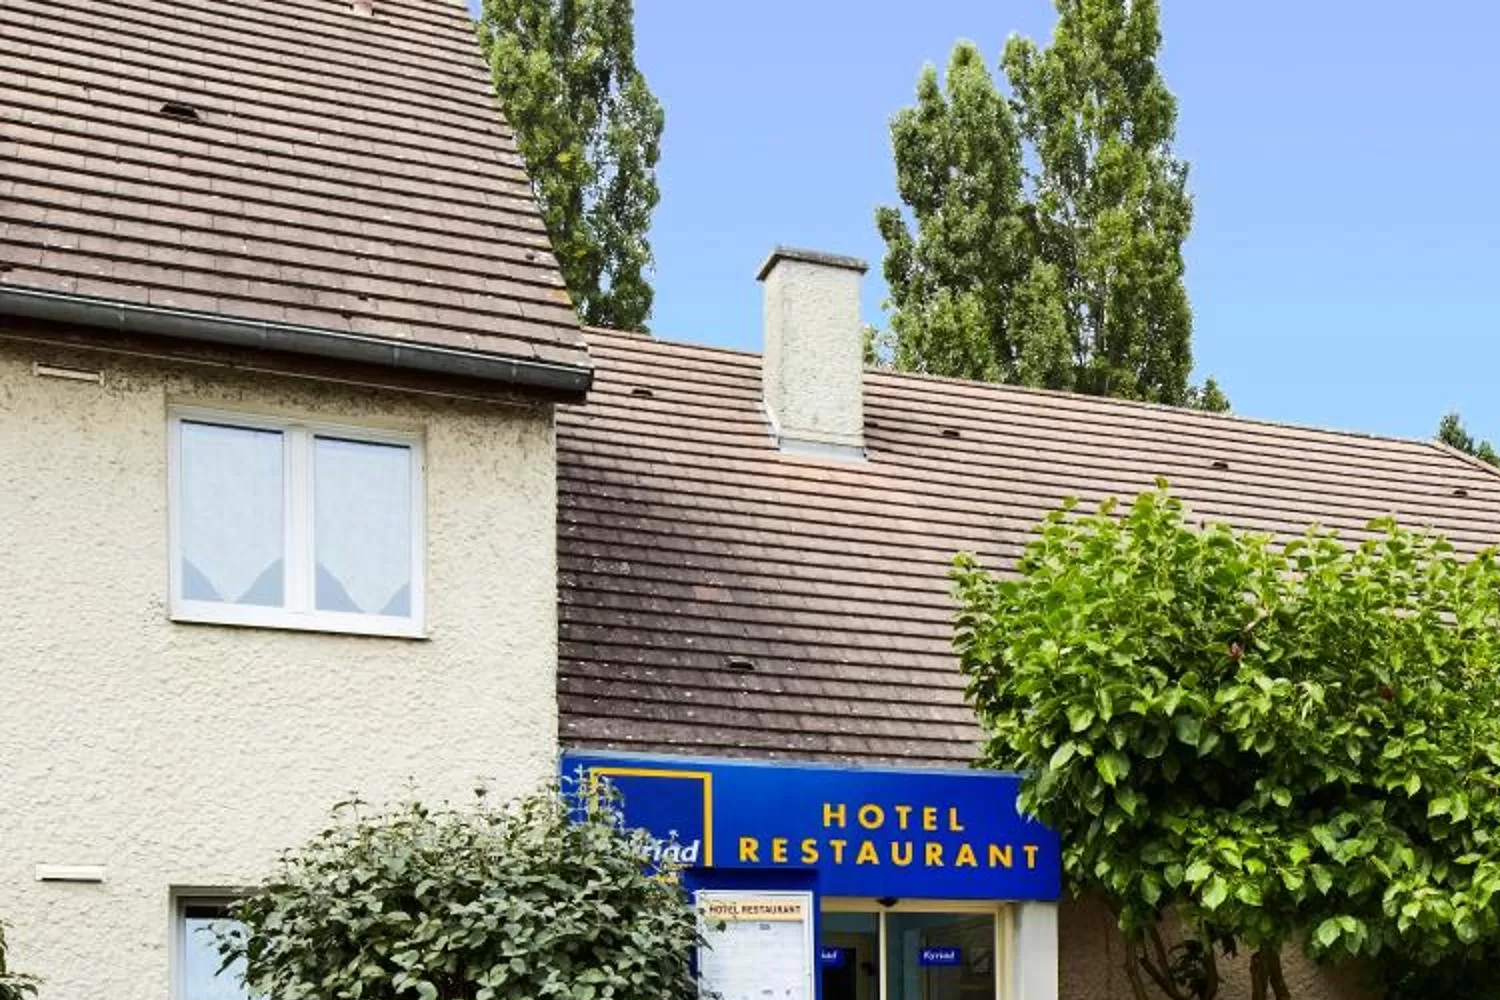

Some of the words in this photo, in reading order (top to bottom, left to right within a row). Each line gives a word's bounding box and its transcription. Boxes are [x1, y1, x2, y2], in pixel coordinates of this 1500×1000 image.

[823, 803, 964, 831] HOTEL
[739, 837, 1039, 869] RESTAURANT
[709, 905, 739, 915] HOTEL
[742, 905, 801, 915] RESTAURANT
